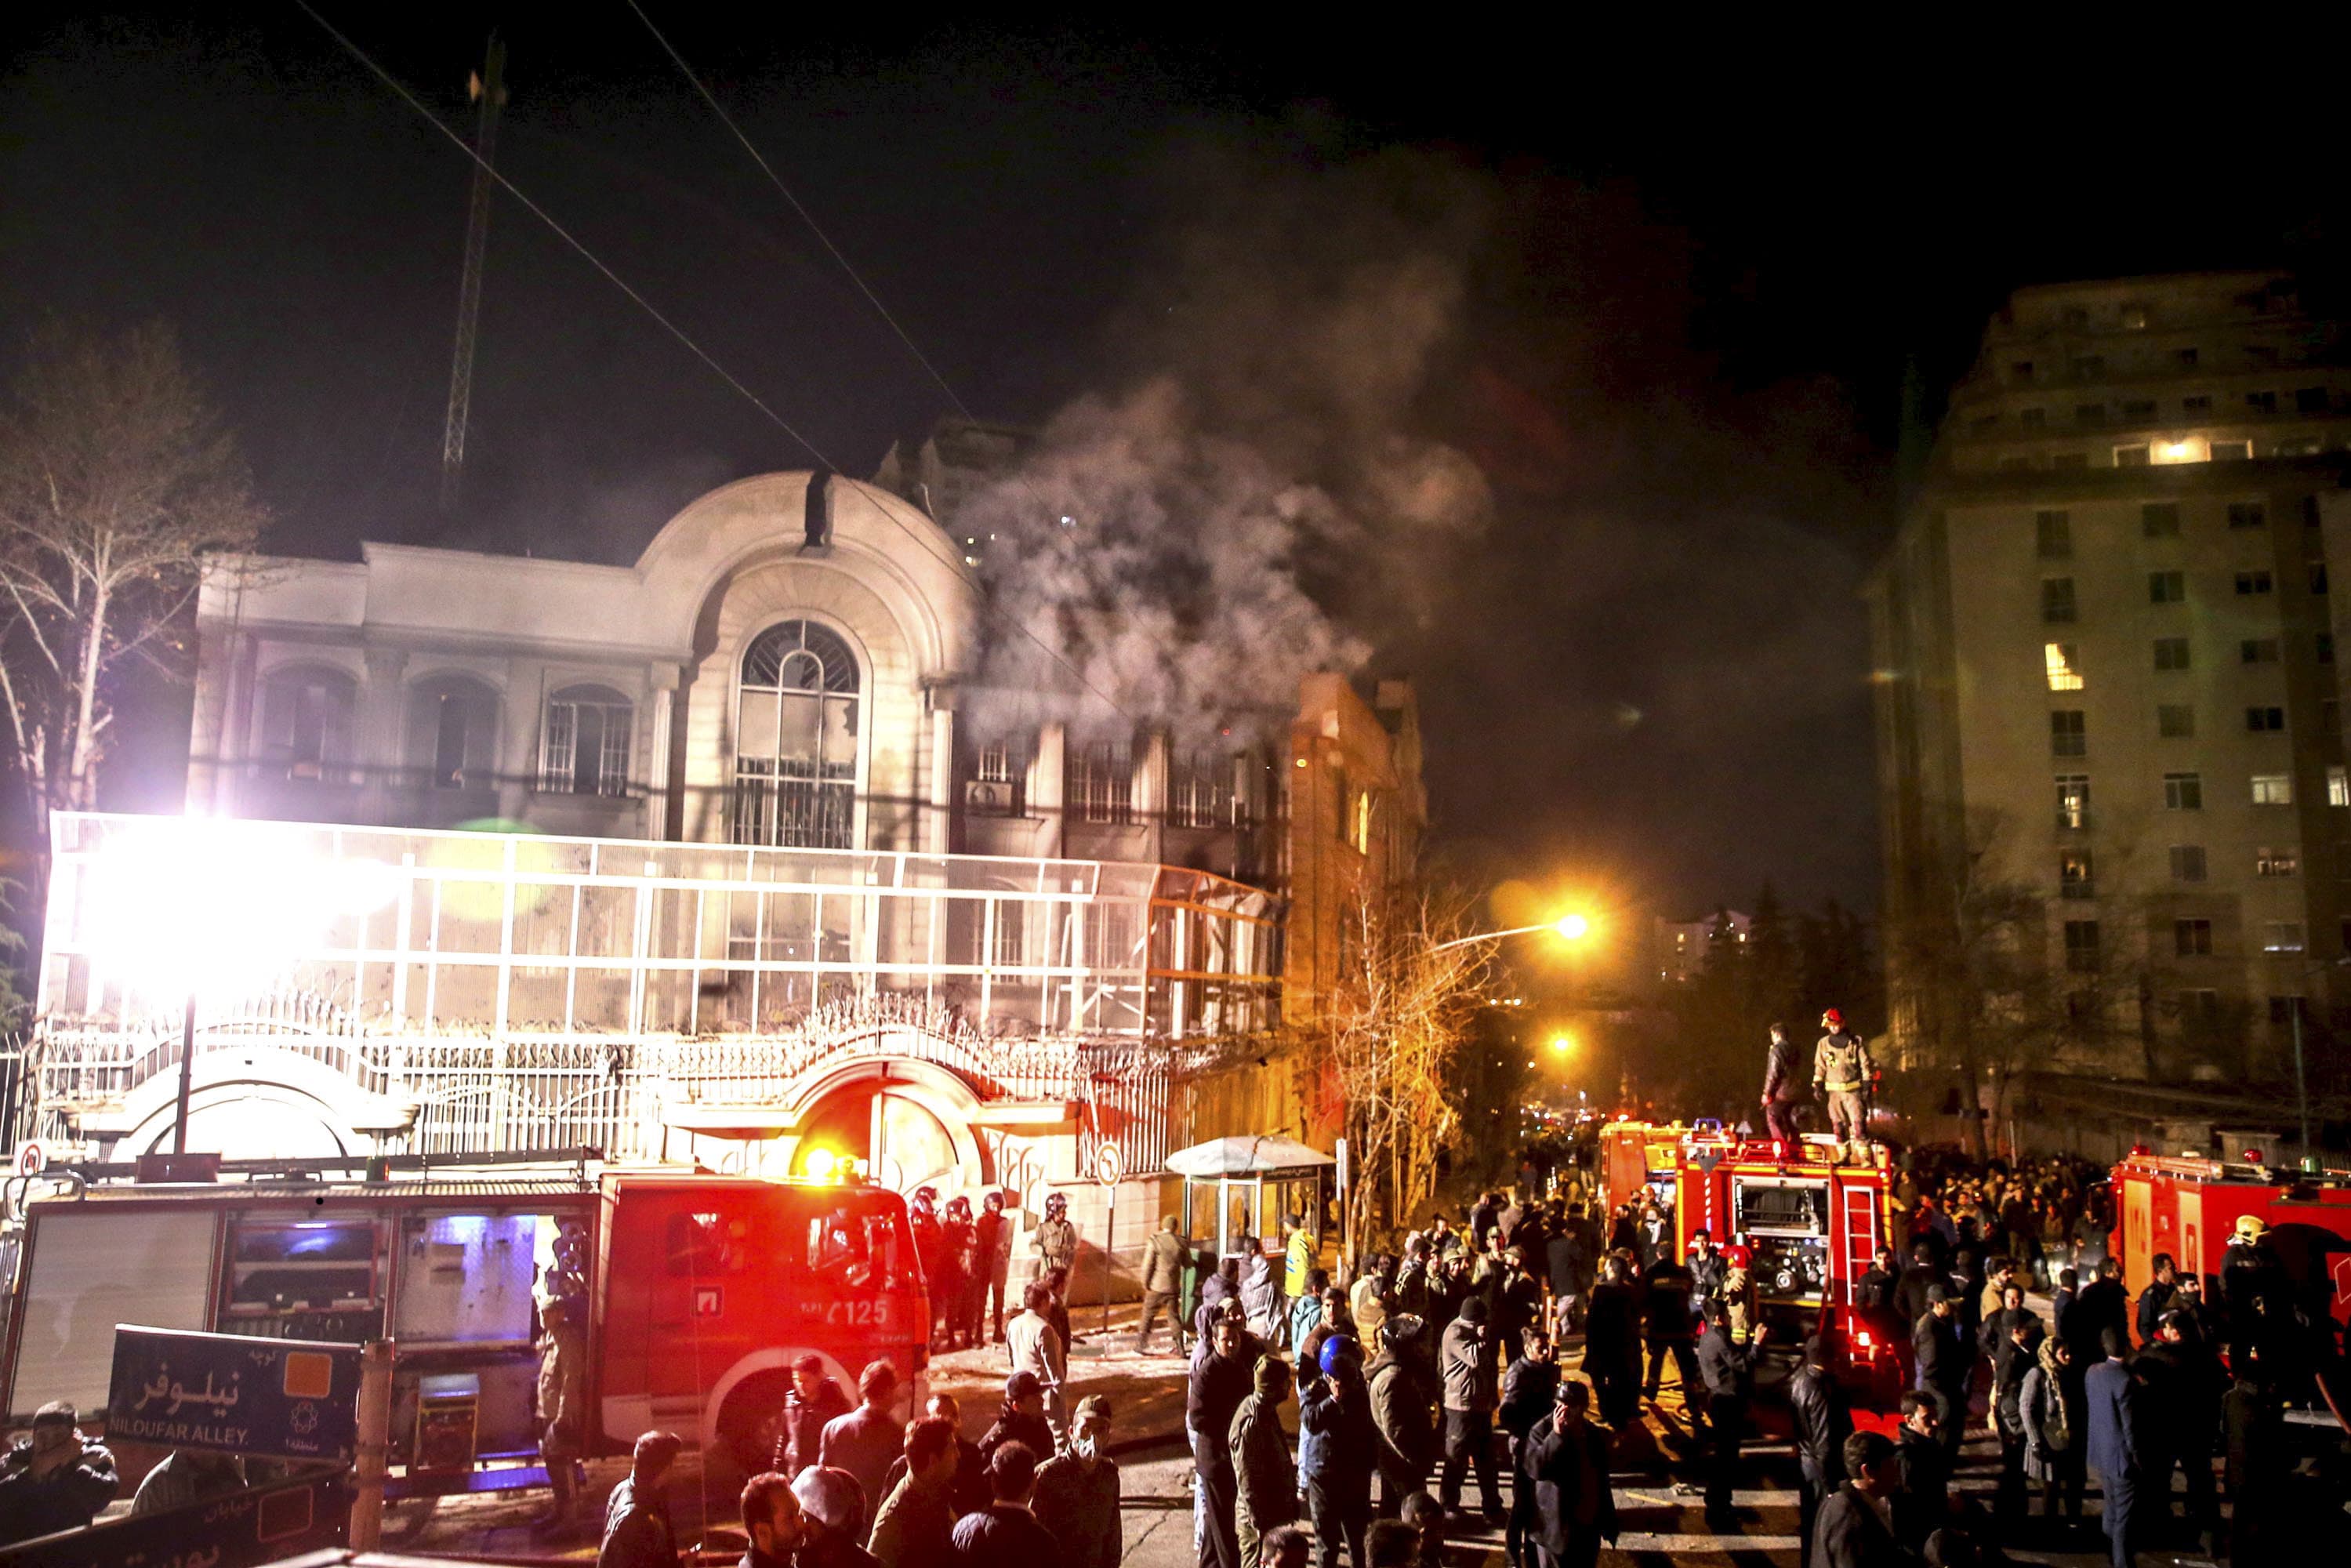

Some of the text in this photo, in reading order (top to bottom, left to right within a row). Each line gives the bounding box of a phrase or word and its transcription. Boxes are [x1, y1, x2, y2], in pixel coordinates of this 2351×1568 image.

[844, 1299, 887, 1326] 125
[132, 1362, 240, 1418] نیلوفر
[109, 1417, 188, 1440] NILOUFAR
